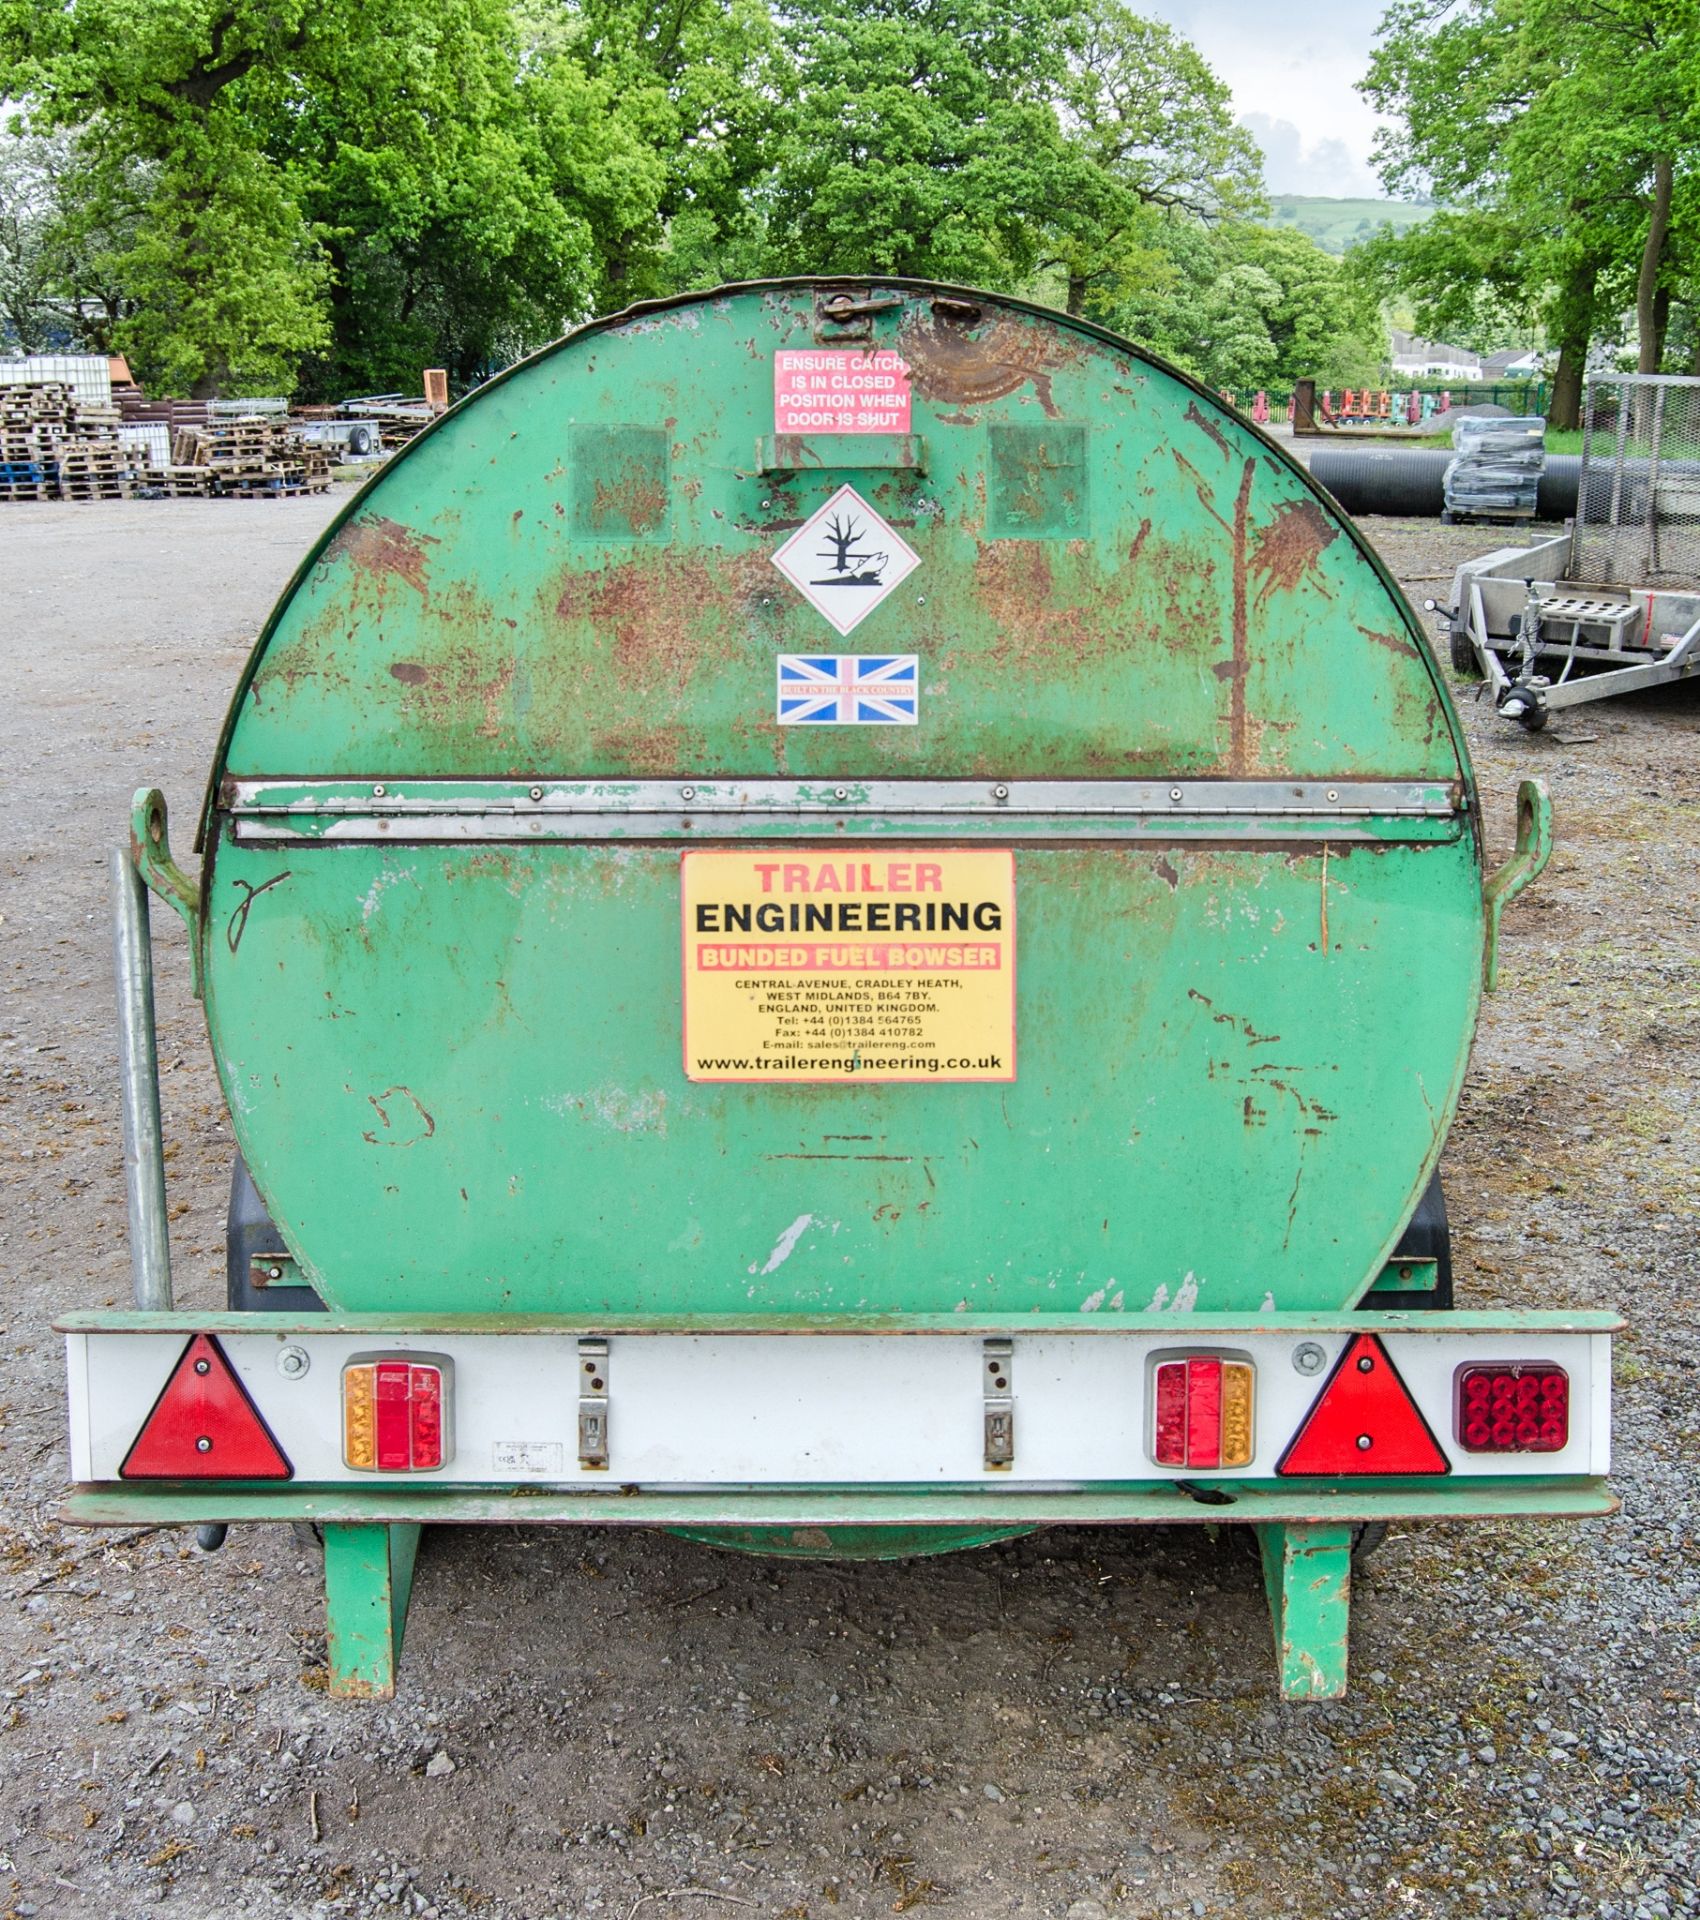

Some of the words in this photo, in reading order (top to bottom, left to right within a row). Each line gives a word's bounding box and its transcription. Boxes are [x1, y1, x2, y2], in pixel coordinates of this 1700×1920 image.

[782, 357, 846, 370] ENSURE
[851, 357, 904, 371] CATCH
[791, 376, 806, 389] IS
[811, 376, 826, 389] IN
[831, 375, 896, 389] CLOSED
[780, 394, 855, 408] POSITION
[860, 394, 907, 408] WHEN
[787, 413, 837, 426] DOOR
[839, 413, 853, 426] IS
[857, 412, 899, 426] SHUT
[839, 686, 869, 695] BLACK
[870, 686, 912, 695] COUNTRY
[754, 864, 943, 892] TRAILER
[696, 903, 1002, 932] ENGINEERING
[702, 949, 808, 966] BUNDED
[815, 948, 880, 966] FUEL
[888, 948, 996, 966] BOWSER
[735, 980, 792, 989] CENTRAL
[797, 980, 851, 990] AVENUE,
[855, 980, 913, 988] CRADLEY
[917, 979, 963, 989] HEATH,
[766, 992, 801, 1001] WEST
[805, 992, 874, 1002] MIDLANDS,
[878, 992, 901, 1001] B64
[905, 991, 932, 1000] 7BY.
[758, 1004, 822, 1014] ENGLAND,
[826, 1004, 873, 1013] UNITED
[876, 1003, 940, 1013] KINGDOM.
[777, 1016, 799, 1025] Tel:
[803, 1016, 825, 1025] +44
[828, 1016, 874, 1027] (0)1384
[878, 1016, 921, 1025] 564765
[775, 1028, 801, 1037] Fax:
[805, 1028, 827, 1037] +44
[830, 1028, 876, 1039] (0)1384
[879, 1028, 923, 1037] 410782
[763, 1040, 804, 1049] E-mail:
[697, 1055, 1002, 1072] www.trailerengineering.co.uk
